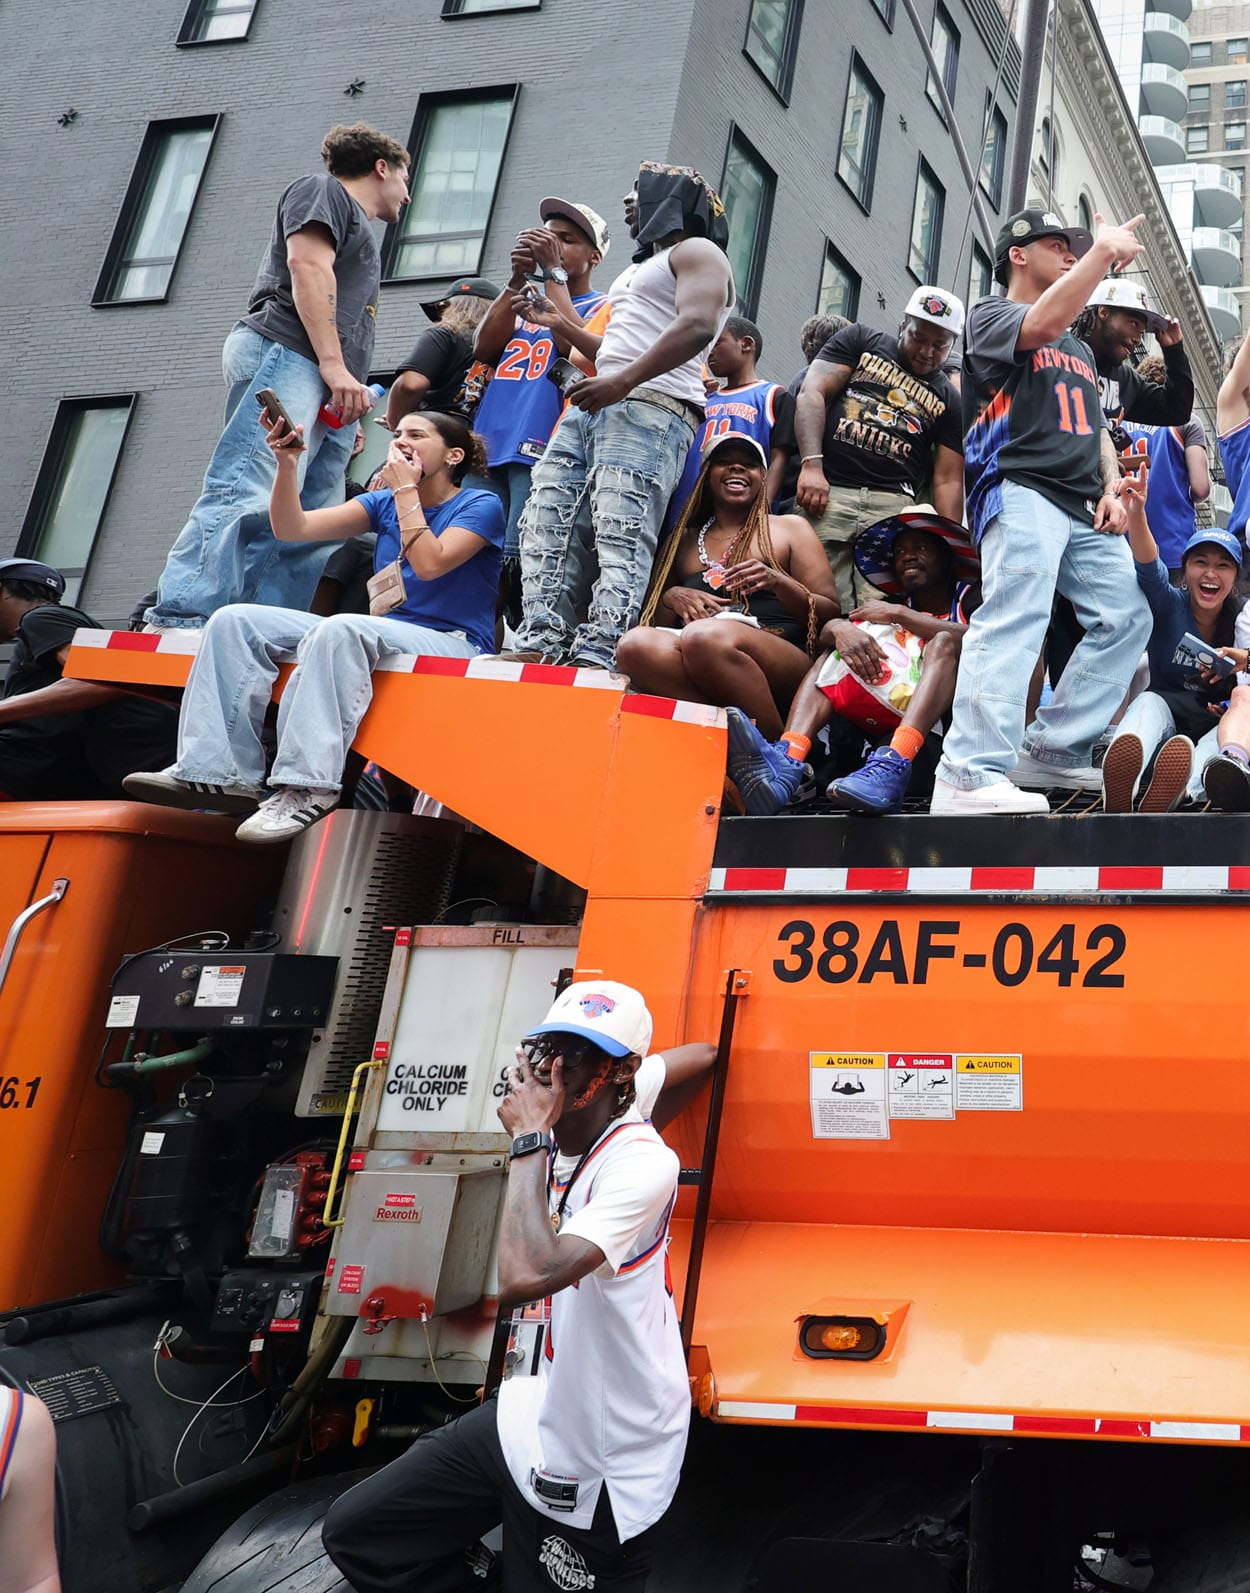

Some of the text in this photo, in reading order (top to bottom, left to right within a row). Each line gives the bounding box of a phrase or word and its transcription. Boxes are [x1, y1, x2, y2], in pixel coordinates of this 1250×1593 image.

[495, 338, 554, 380] 28
[1055, 380, 1094, 435] 11
[833, 417, 912, 464] KNICKS
[493, 930, 525, 944] FILL
[773, 920, 1127, 988] 38AF-042
[837, 1057, 874, 1066] CAUTION
[912, 1058, 945, 1066] DANGER
[977, 1060, 1013, 1069] CAUTION
[395, 1064, 467, 1079] CALCIUM
[387, 1080, 468, 1096] CHLORIDE
[402, 1097, 447, 1111] ONLY
[376, 1207, 419, 1220] Rexroth
